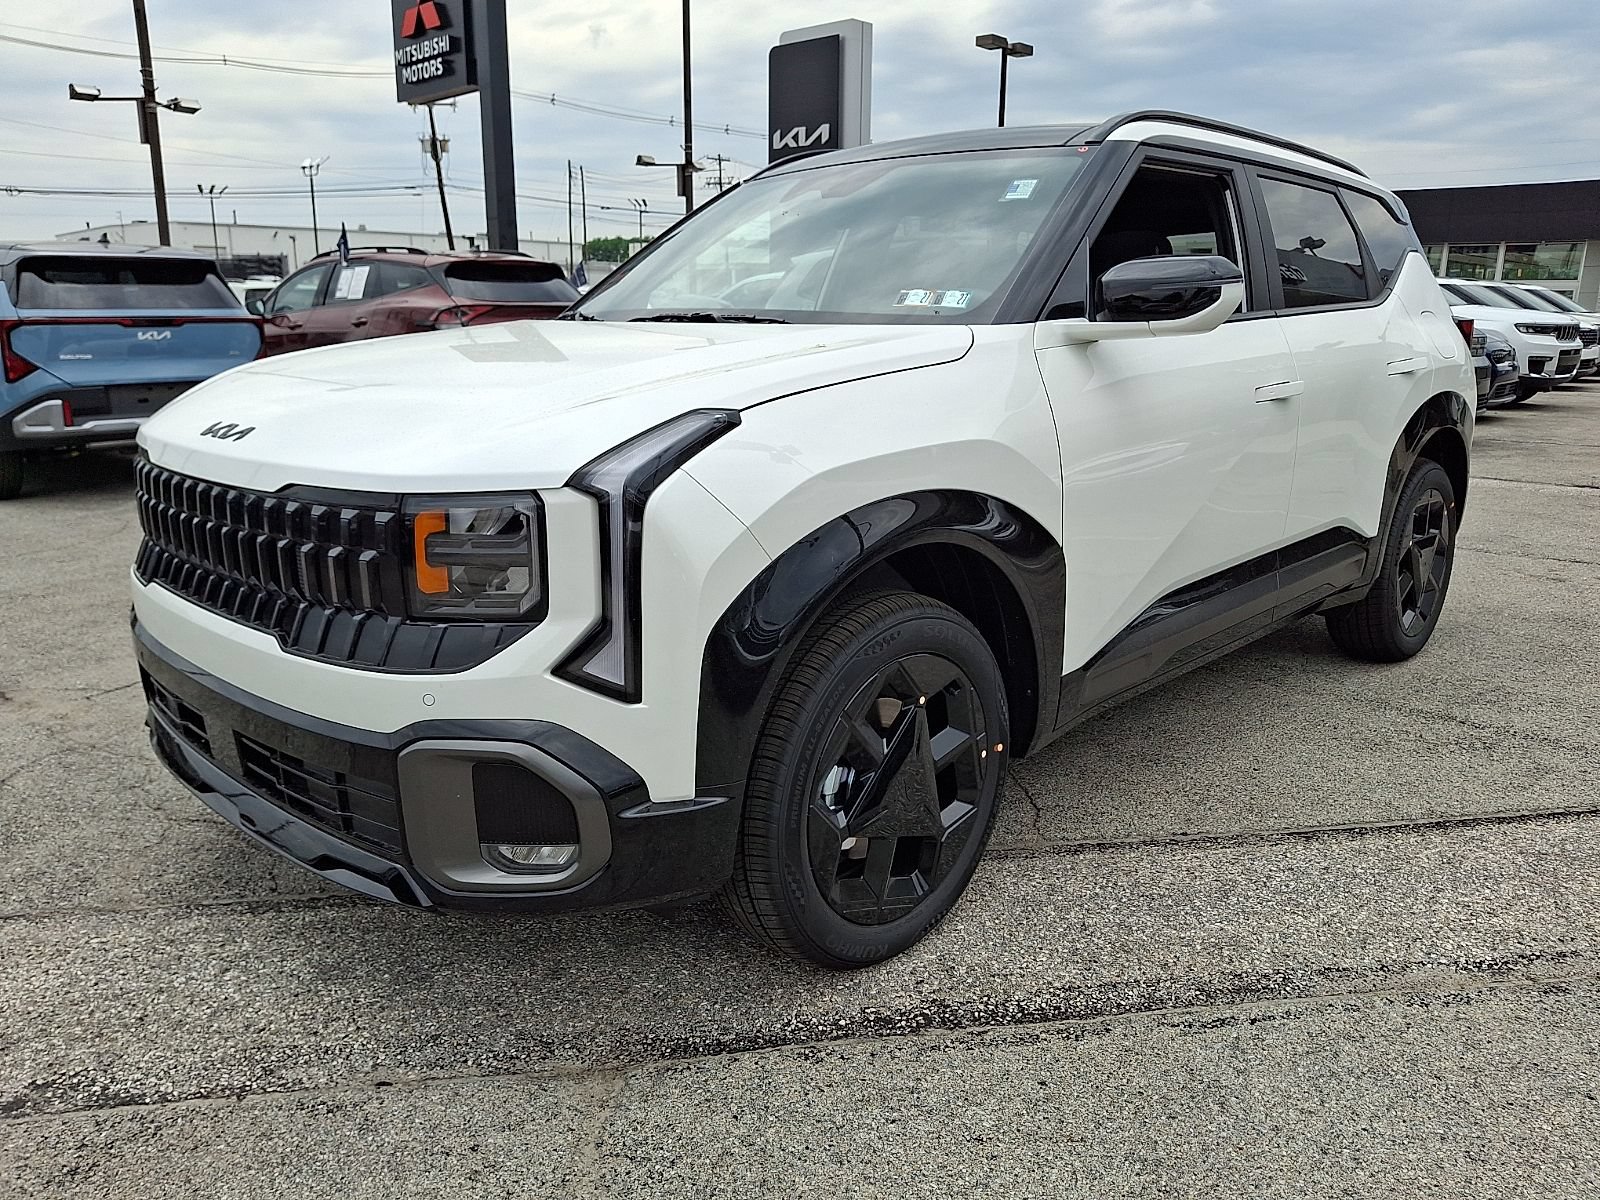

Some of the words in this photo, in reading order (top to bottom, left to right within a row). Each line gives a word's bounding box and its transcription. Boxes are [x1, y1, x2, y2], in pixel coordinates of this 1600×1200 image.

[395, 34, 450, 66] MITSUBISHI
[402, 57, 443, 84] MOTORS
[773, 123, 830, 149] KIA
[919, 292, 932, 304] 27
[956, 293, 969, 305] 27
[137, 330, 171, 341] KIA
[200, 421, 256, 442] KIA
[825, 934, 889, 958] KUMHO
